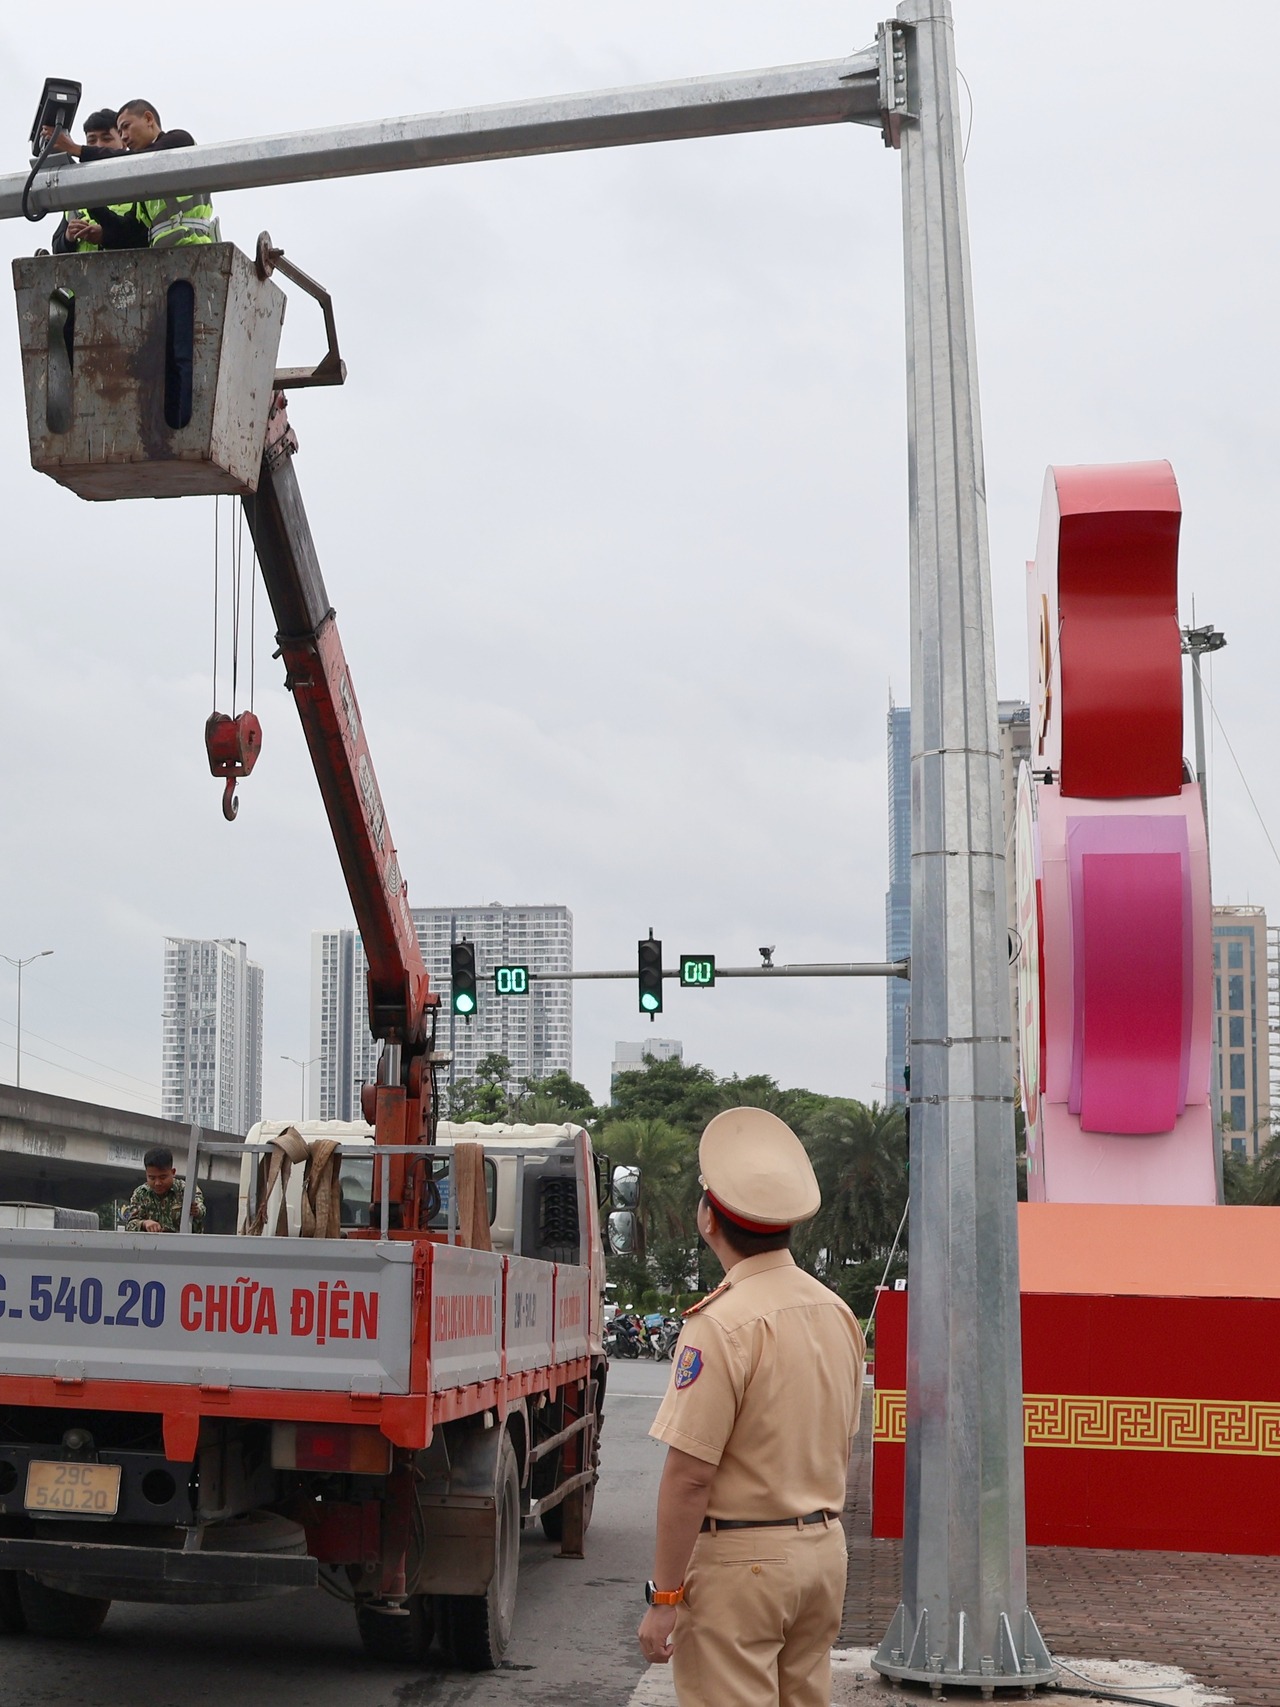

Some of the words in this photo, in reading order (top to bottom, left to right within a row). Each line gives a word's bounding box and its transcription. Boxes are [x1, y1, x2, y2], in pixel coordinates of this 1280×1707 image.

[497, 968, 526, 993] 00
[684, 961, 712, 984] 00
[180, 1276, 278, 1335] CHỮA
[54, 1466, 93, 1487] 29C
[36, 1487, 108, 1509] 540.20
